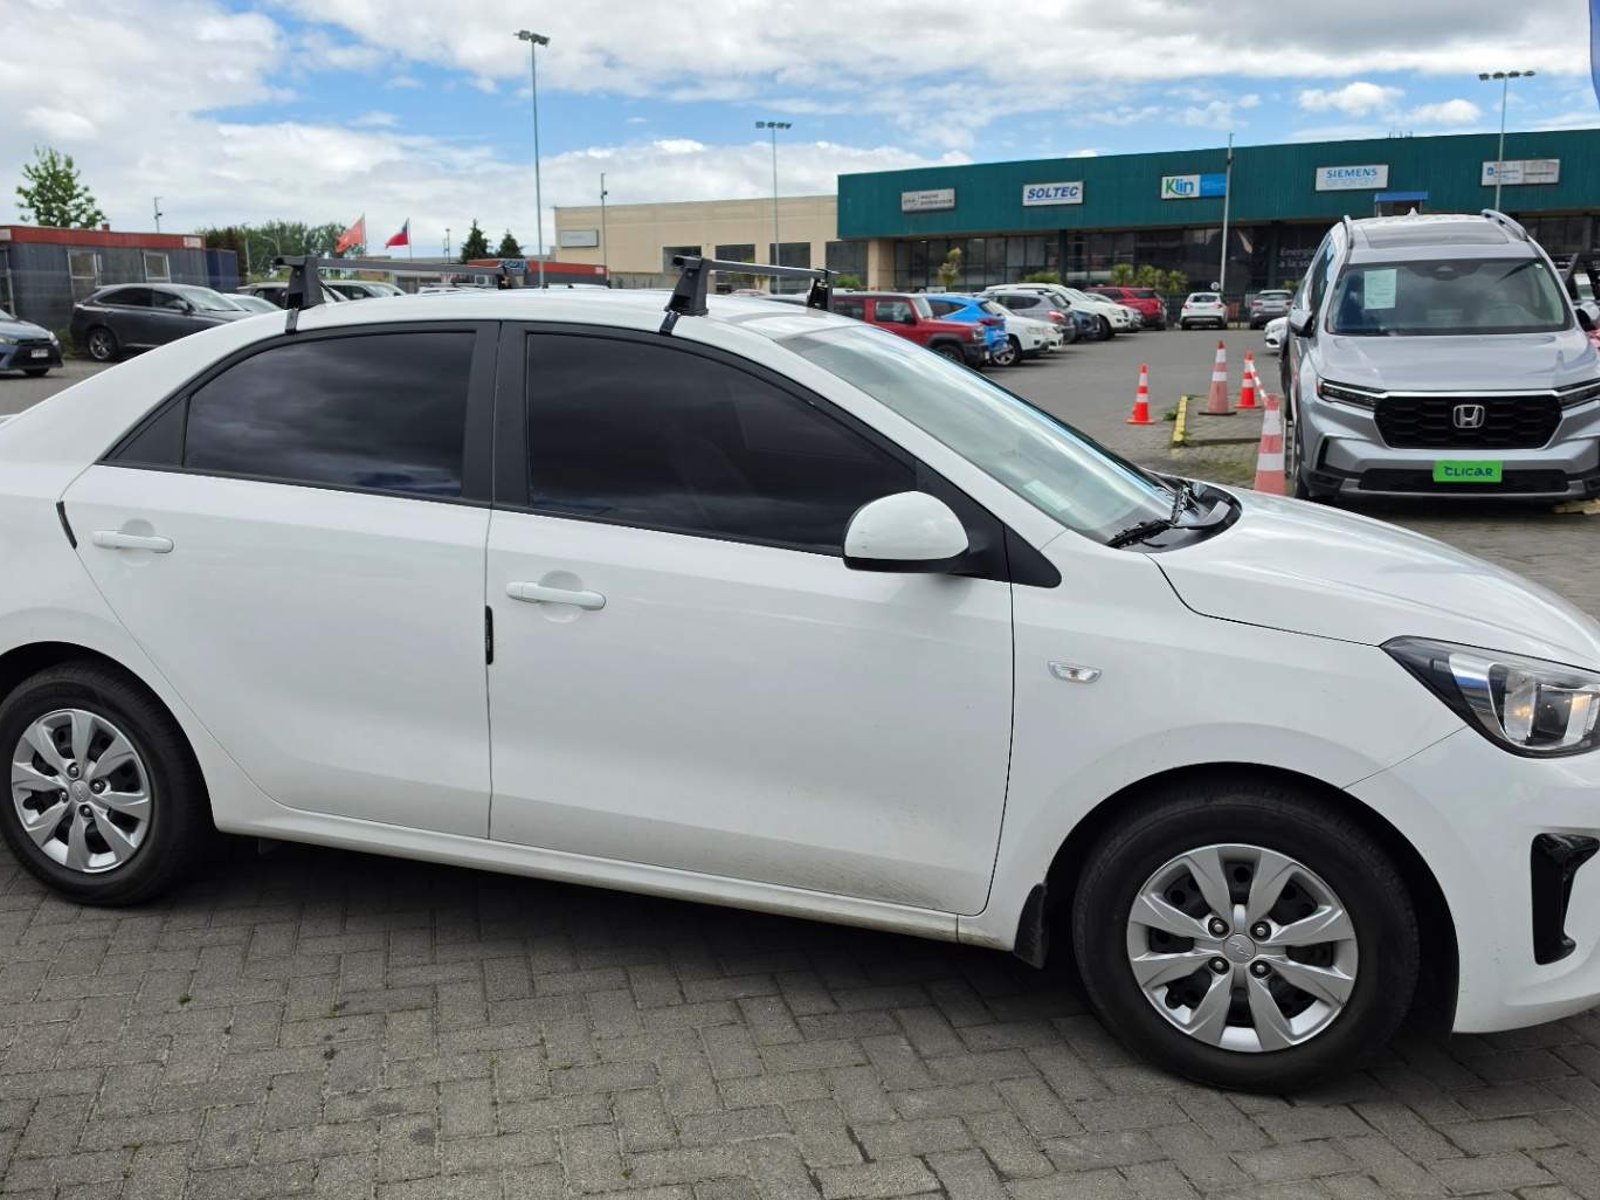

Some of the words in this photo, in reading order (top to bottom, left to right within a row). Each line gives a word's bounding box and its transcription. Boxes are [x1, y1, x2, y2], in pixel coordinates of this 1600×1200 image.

[1326, 168, 1377, 178] SIEMENS
[1027, 186, 1079, 199] SOLTEC
[1166, 178, 1194, 195] Klin
